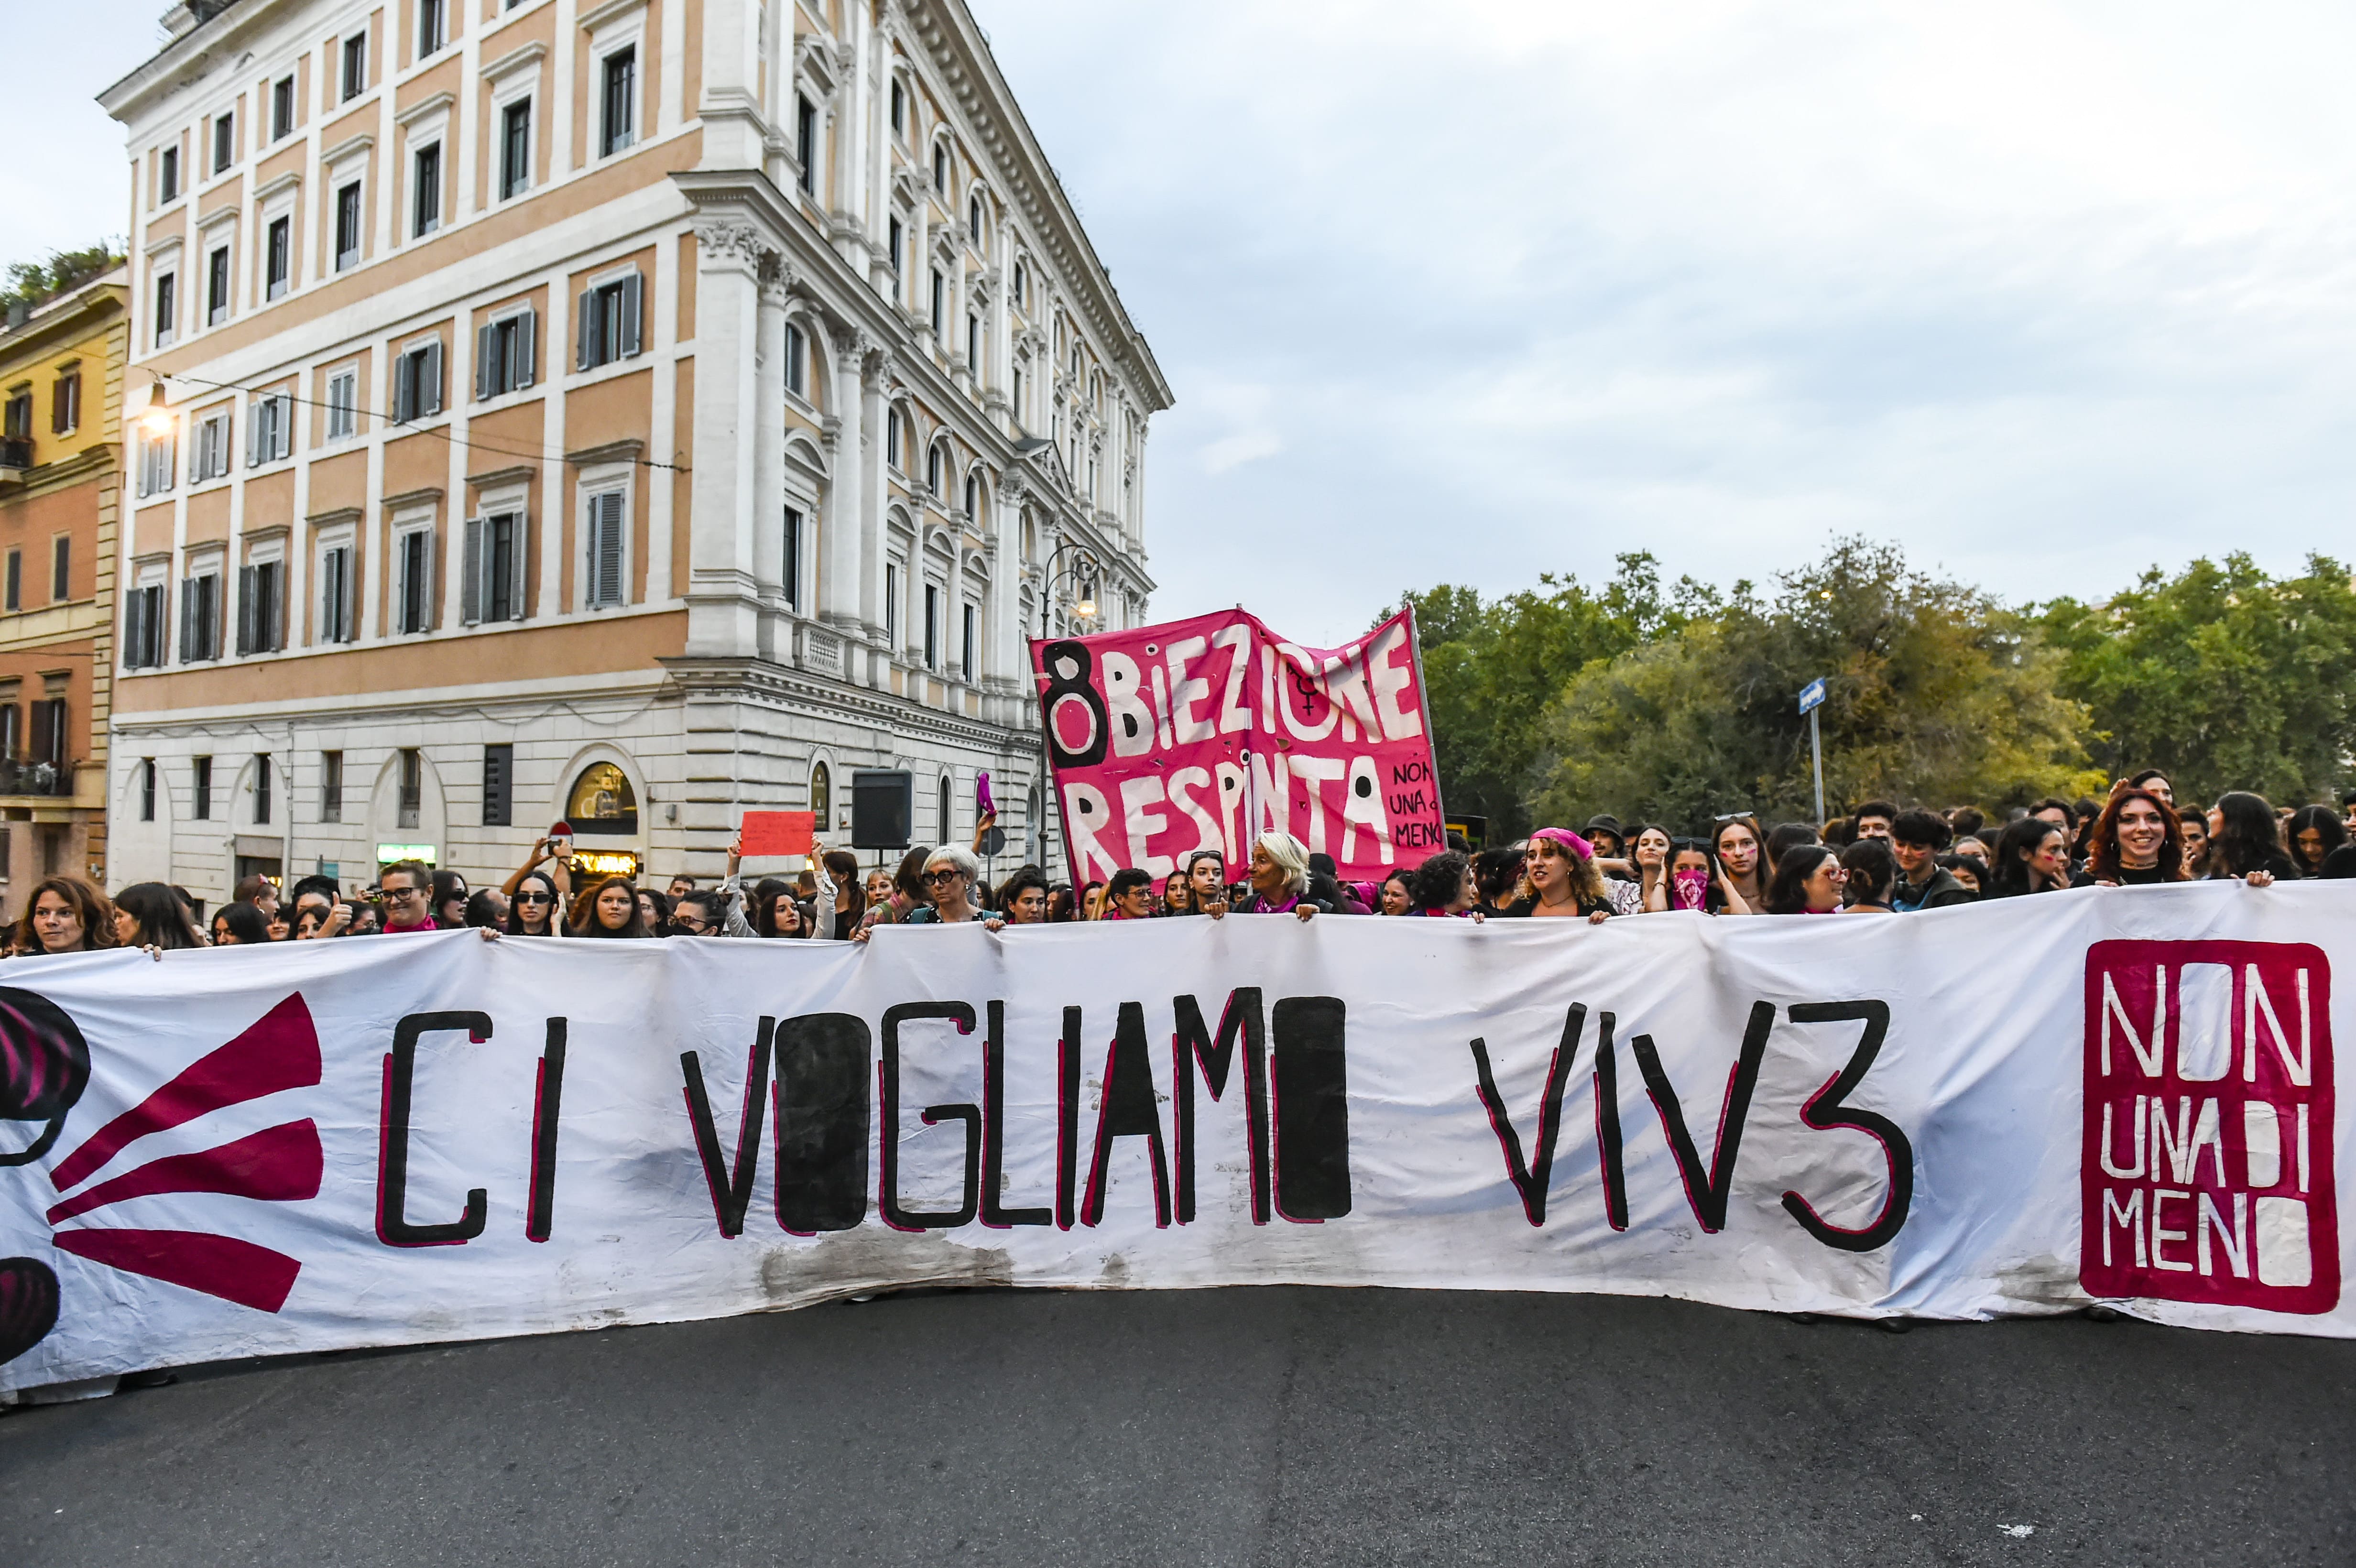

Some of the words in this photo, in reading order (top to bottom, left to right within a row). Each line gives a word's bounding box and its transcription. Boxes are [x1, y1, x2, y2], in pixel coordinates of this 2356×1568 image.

[1389, 789, 1427, 815] UNA
[1393, 761, 1433, 785] NON
[1395, 822, 1442, 847] MENO
[2101, 962, 2312, 1086] NON
[375, 1011, 567, 1246] CI
[680, 987, 1353, 1240] VOGLIAMO
[2100, 1094, 2227, 1188] UNA
[2244, 1100, 2310, 1193] DI
[2103, 1188, 2313, 1287] MENO
